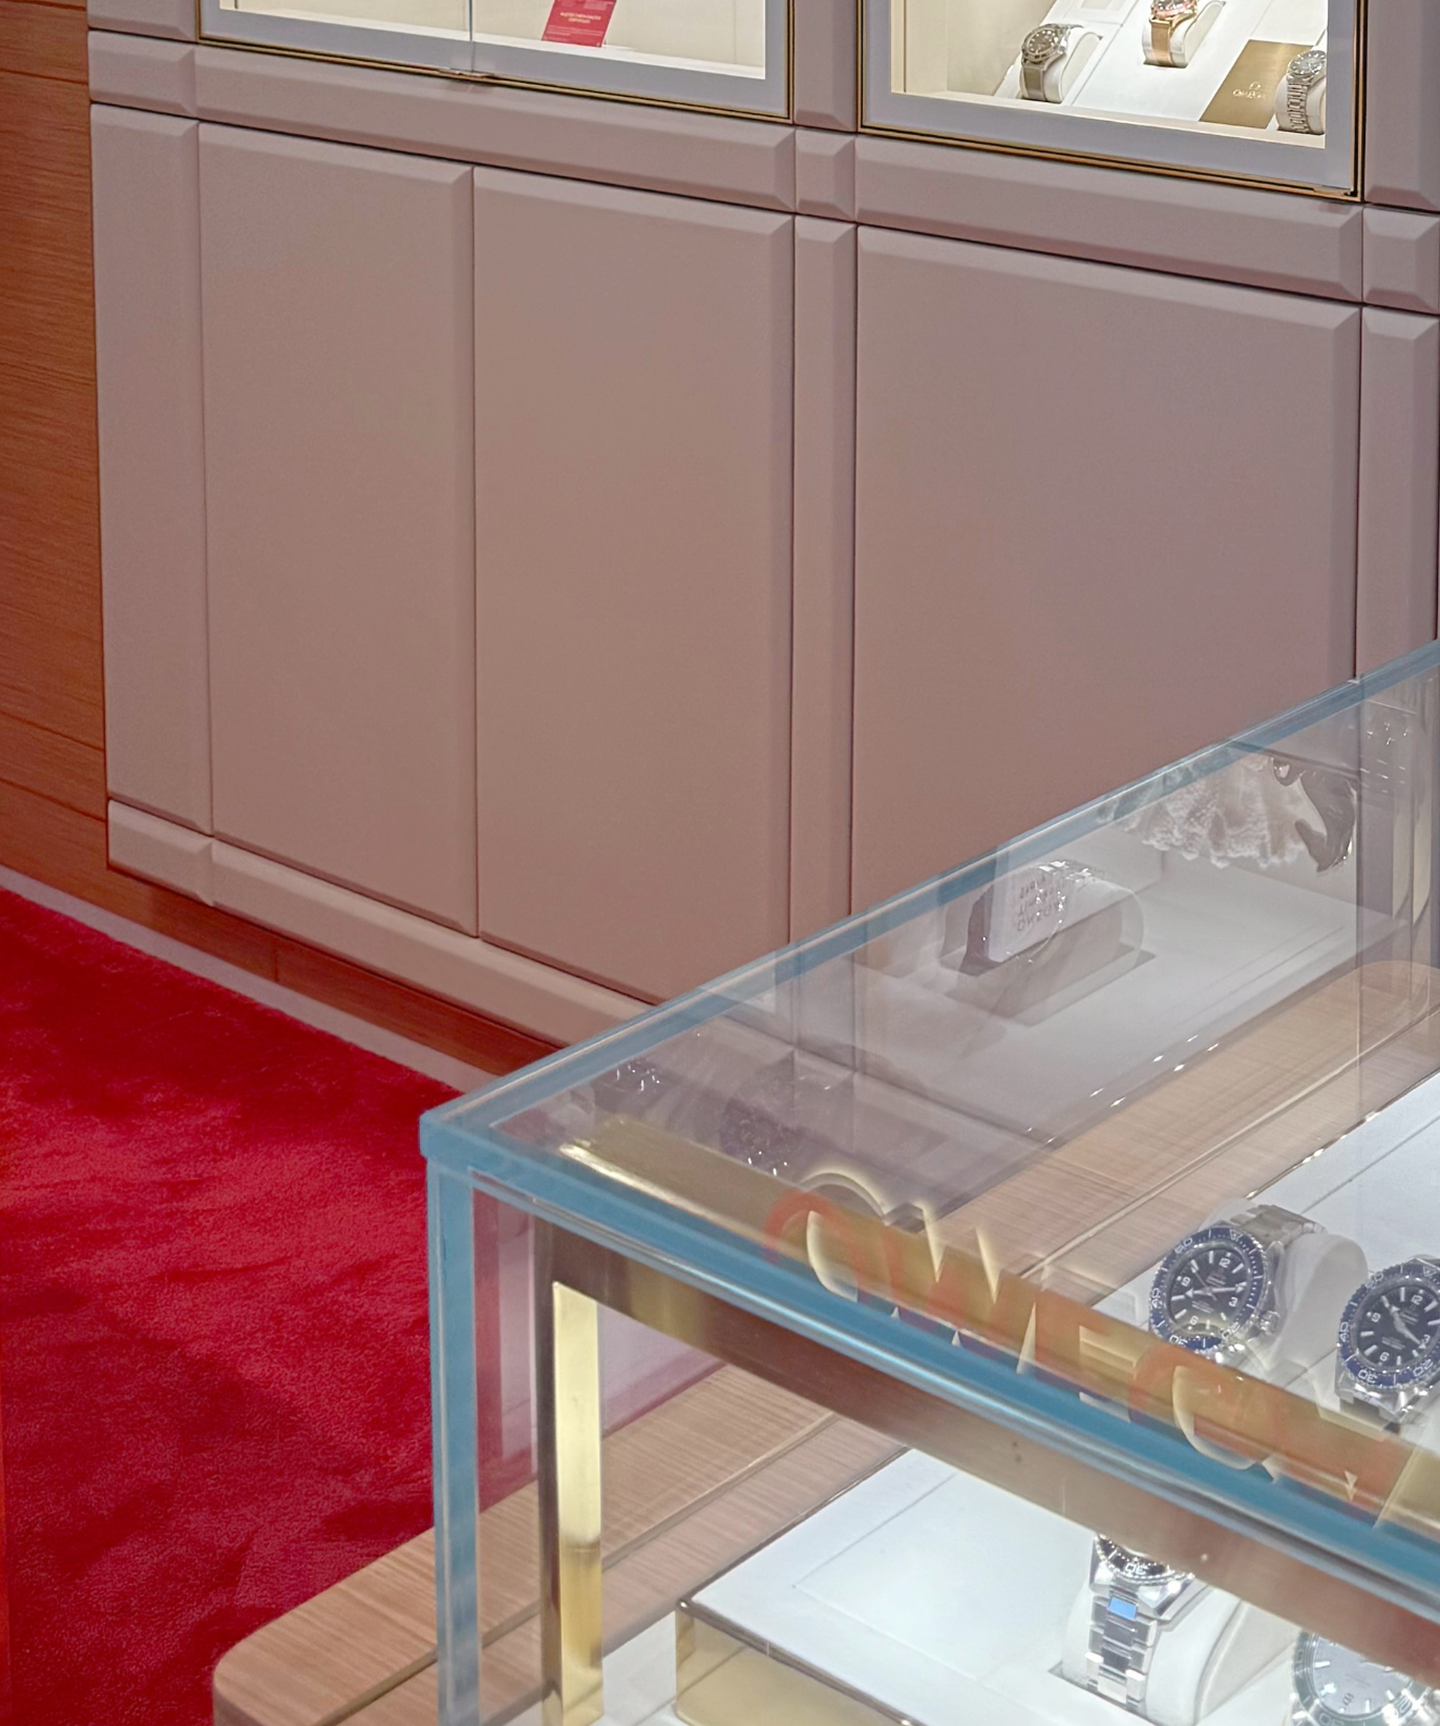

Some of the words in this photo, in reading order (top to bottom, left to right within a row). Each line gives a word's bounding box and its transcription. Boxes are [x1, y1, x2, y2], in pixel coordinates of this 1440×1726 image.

[1228, 1297, 1238, 1307] 3
[1380, 1351, 1389, 1361] 6
[1358, 1369, 1378, 1384] 30
